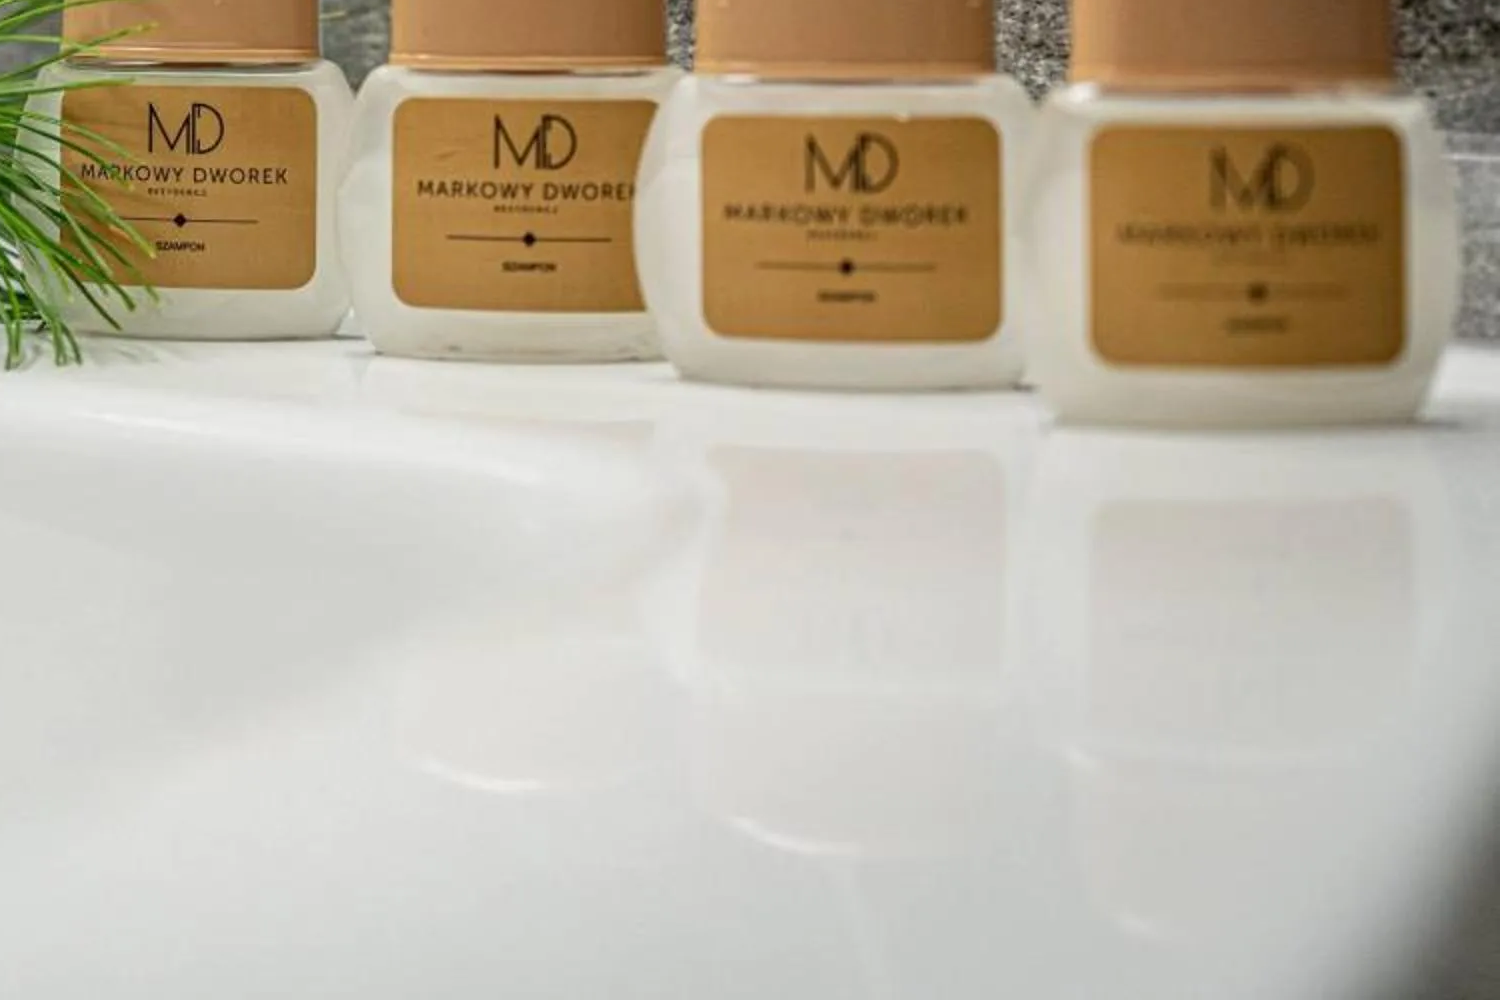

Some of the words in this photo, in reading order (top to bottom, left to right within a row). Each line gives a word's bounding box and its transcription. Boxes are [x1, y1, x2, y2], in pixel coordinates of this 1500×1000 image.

[147, 101, 225, 156] MD
[493, 113, 578, 171] MD
[193, 167, 289, 185] DWOREK
[416, 179, 535, 199] MARKOWY
[542, 181, 635, 202] DWORE
[804, 131, 900, 195] MD
